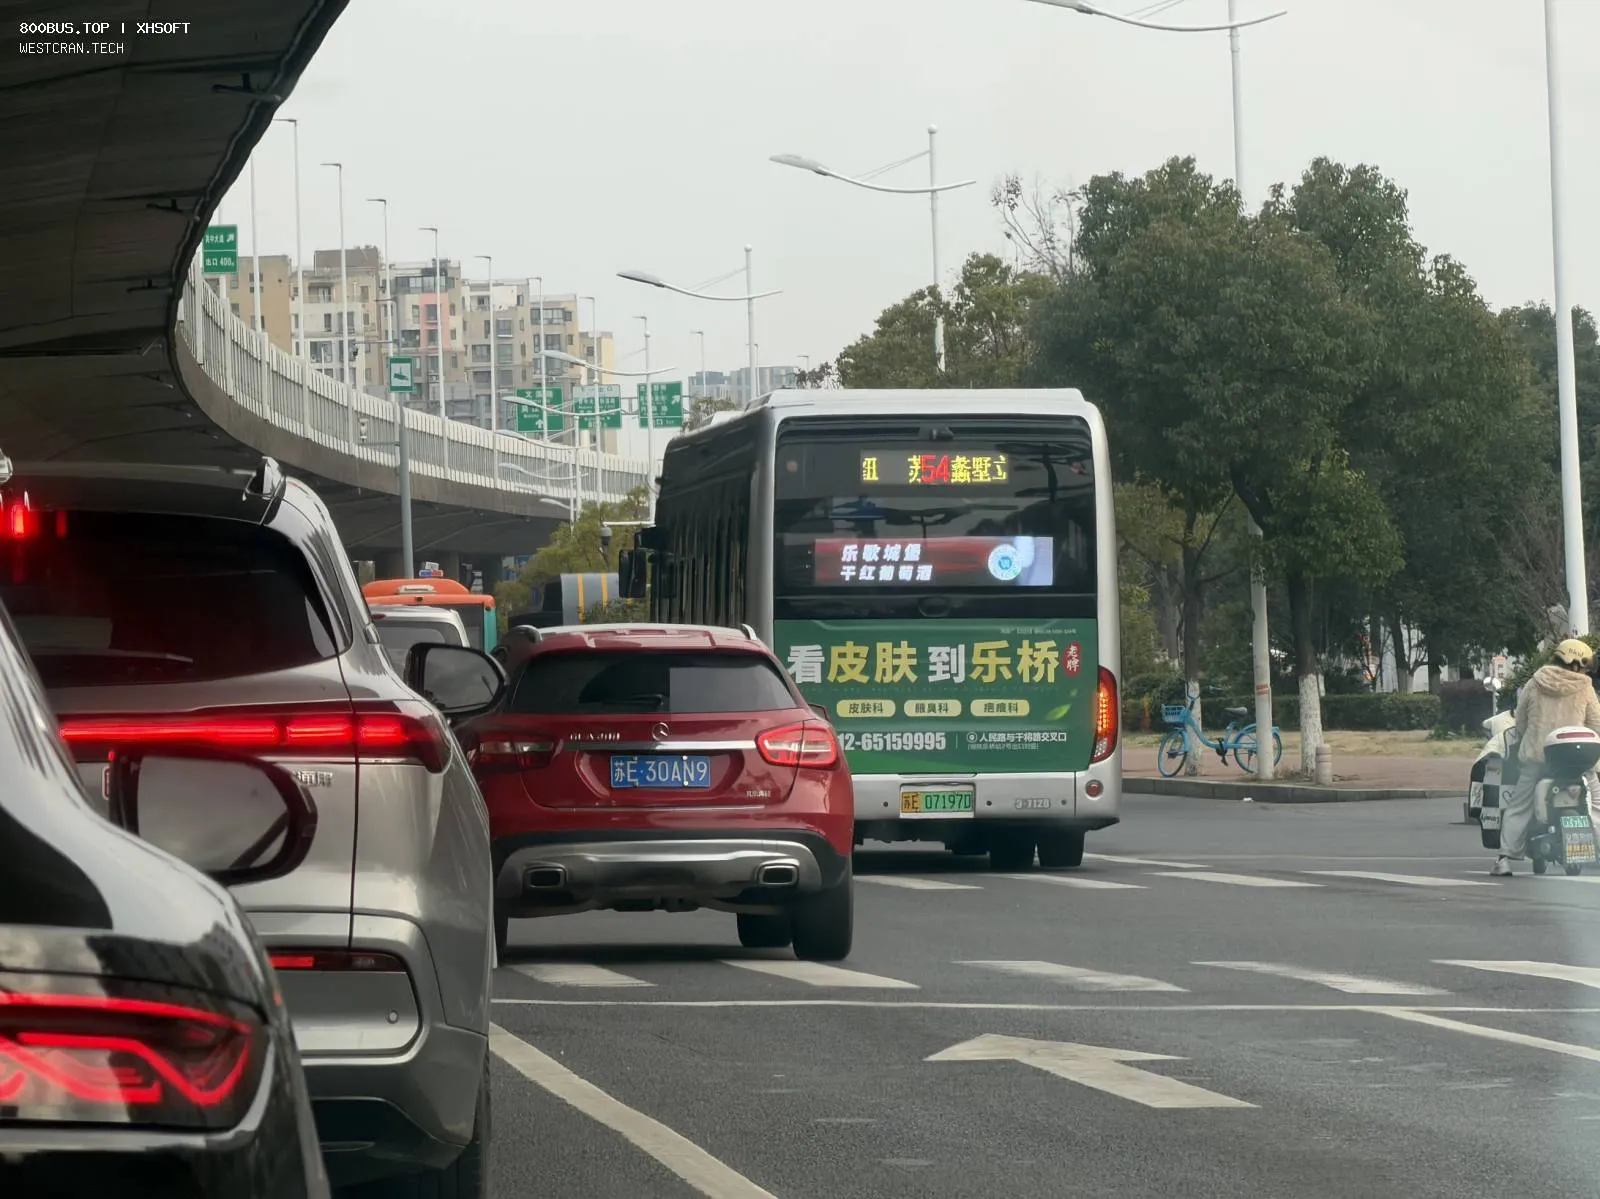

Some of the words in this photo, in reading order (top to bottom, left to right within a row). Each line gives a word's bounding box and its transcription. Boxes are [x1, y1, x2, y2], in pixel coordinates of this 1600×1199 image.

[921, 454, 949, 483] 54
[786, 640, 1060, 684] 看皮肤到乐桥
[848, 702, 884, 714] 皮肤科
